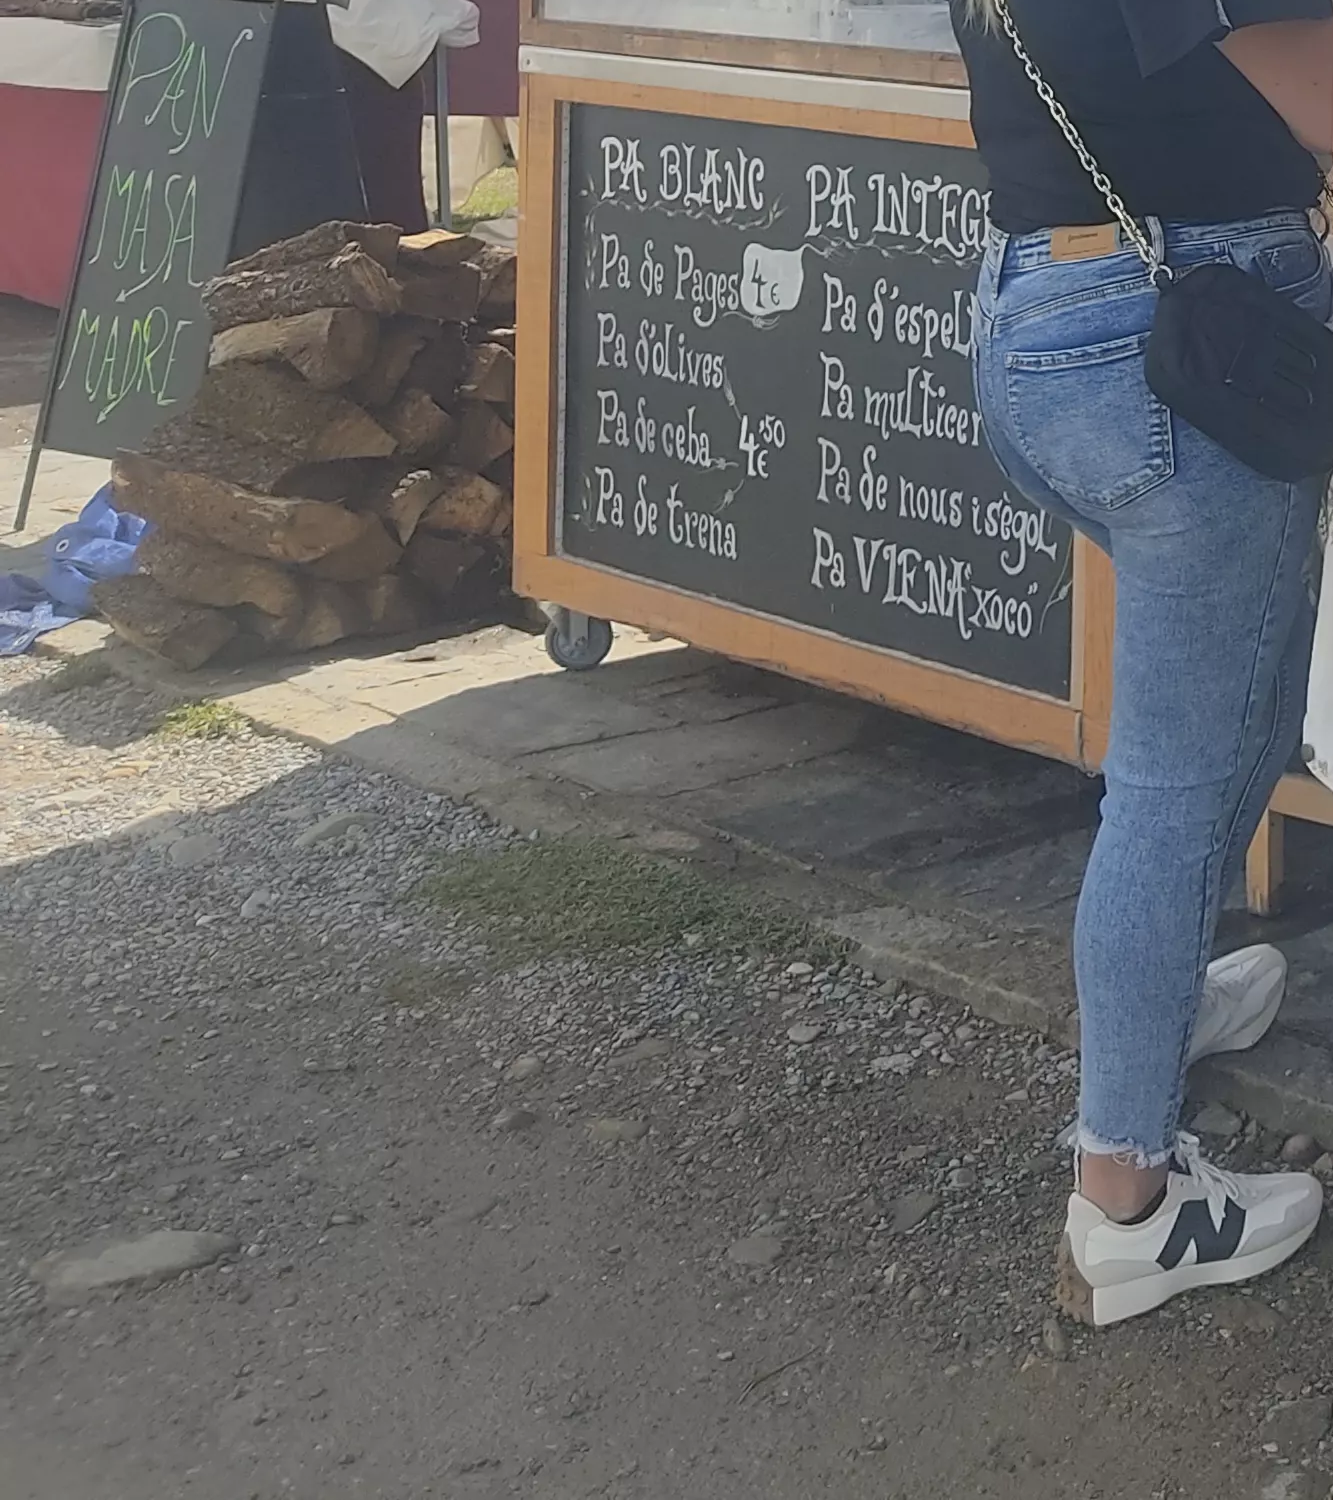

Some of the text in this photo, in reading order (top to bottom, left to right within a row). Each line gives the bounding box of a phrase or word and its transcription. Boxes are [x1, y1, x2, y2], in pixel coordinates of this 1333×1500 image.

[117, 12, 253, 155] PAN
[600, 136, 764, 214] PA BLANC
[804, 164, 859, 240] PA
[89, 164, 203, 287] MASA
[599, 232, 631, 289] Pa
[639, 239, 664, 297] de
[597, 312, 628, 368] Pa
[823, 272, 858, 332] Pa
[57, 306, 194, 406] MADRE
[819, 351, 854, 420] Pa
[597, 389, 712, 468] Pa de ceba
[595, 466, 738, 560] Pa de trena
[817, 436, 851, 504] Pa
[859, 444, 888, 511] de
[899, 474, 963, 528] nous
[811, 527, 846, 588] Pa
